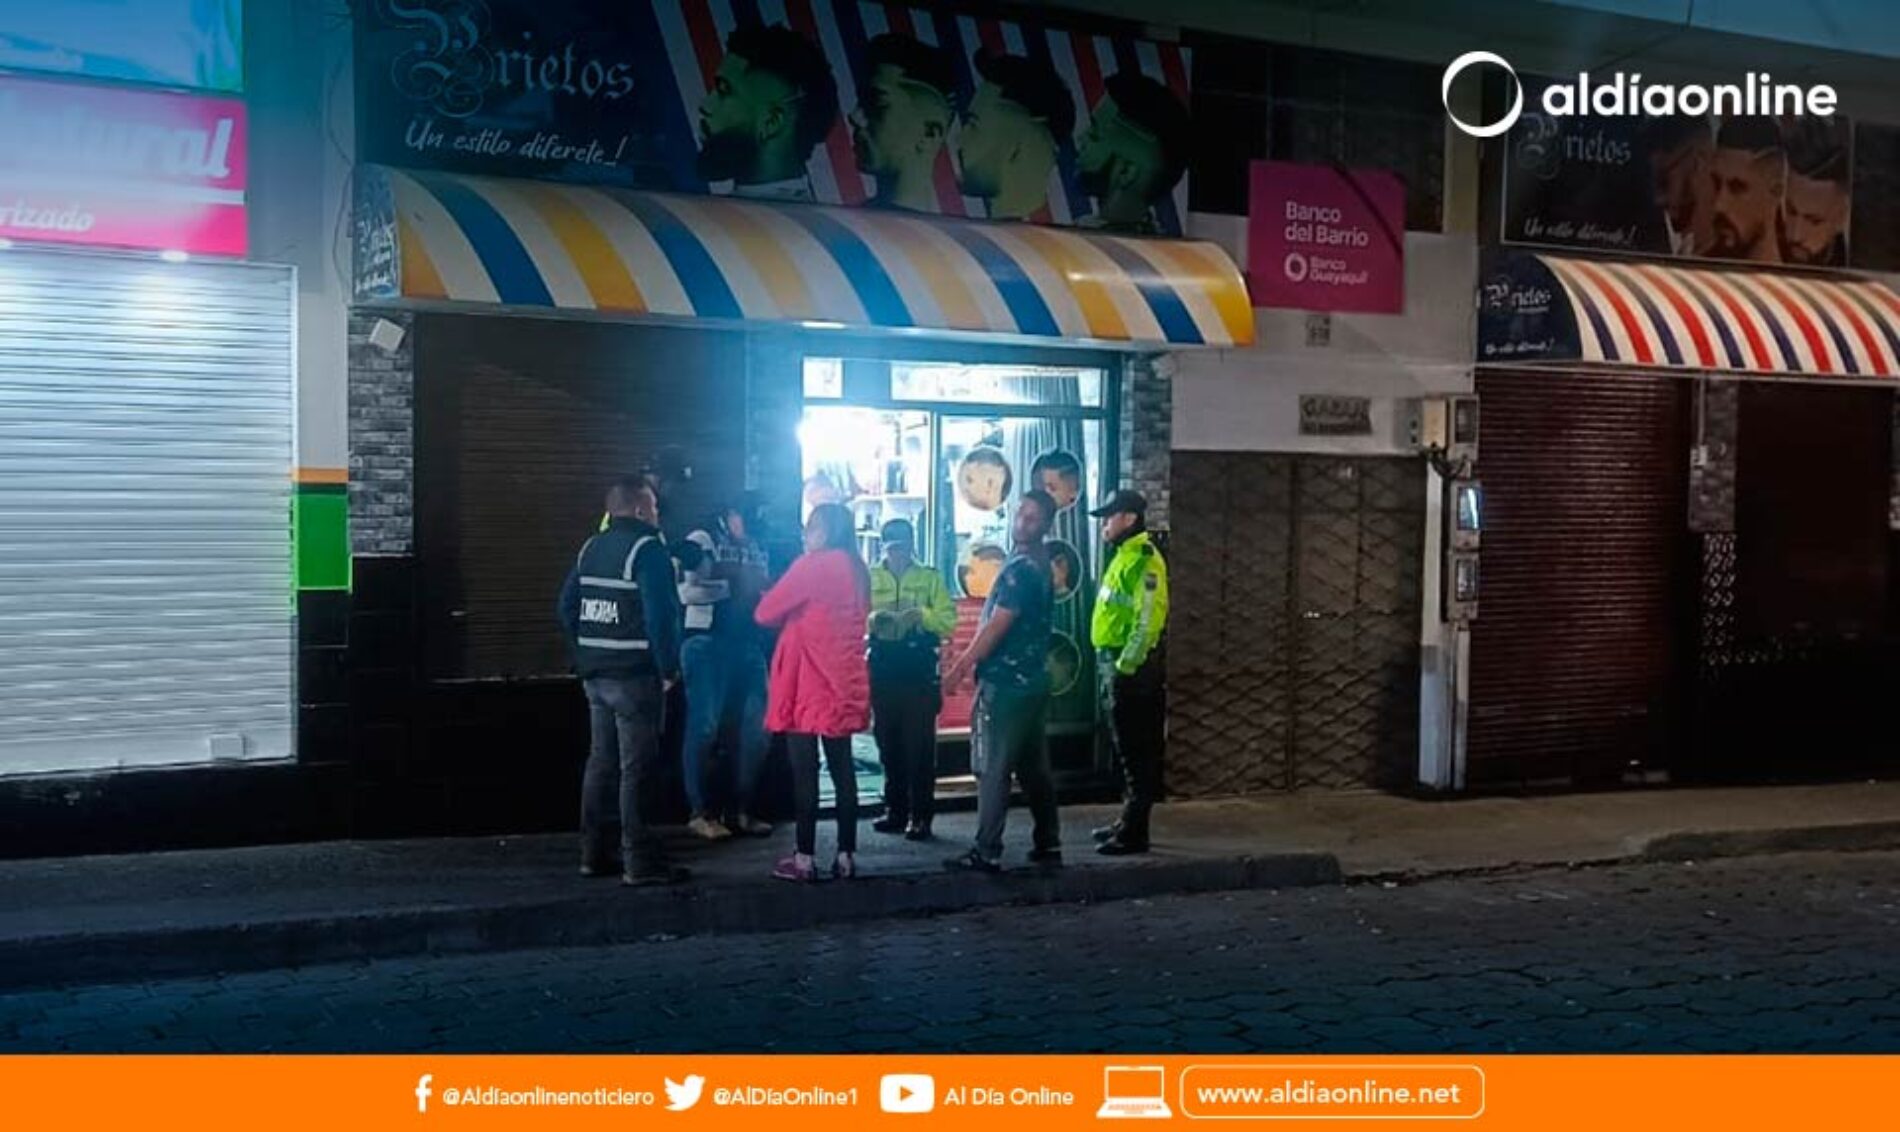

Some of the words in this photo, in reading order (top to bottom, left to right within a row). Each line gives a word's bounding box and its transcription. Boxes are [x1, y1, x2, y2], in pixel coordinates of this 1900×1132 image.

[386, 0, 634, 118] Prietos
[404, 119, 443, 151] Un
[453, 128, 511, 156] estilo
[1286, 201, 1341, 223] Banco
[1284, 223, 1313, 242] del
[1316, 225, 1369, 247] Barrio
[1309, 256, 1346, 271] Banco
